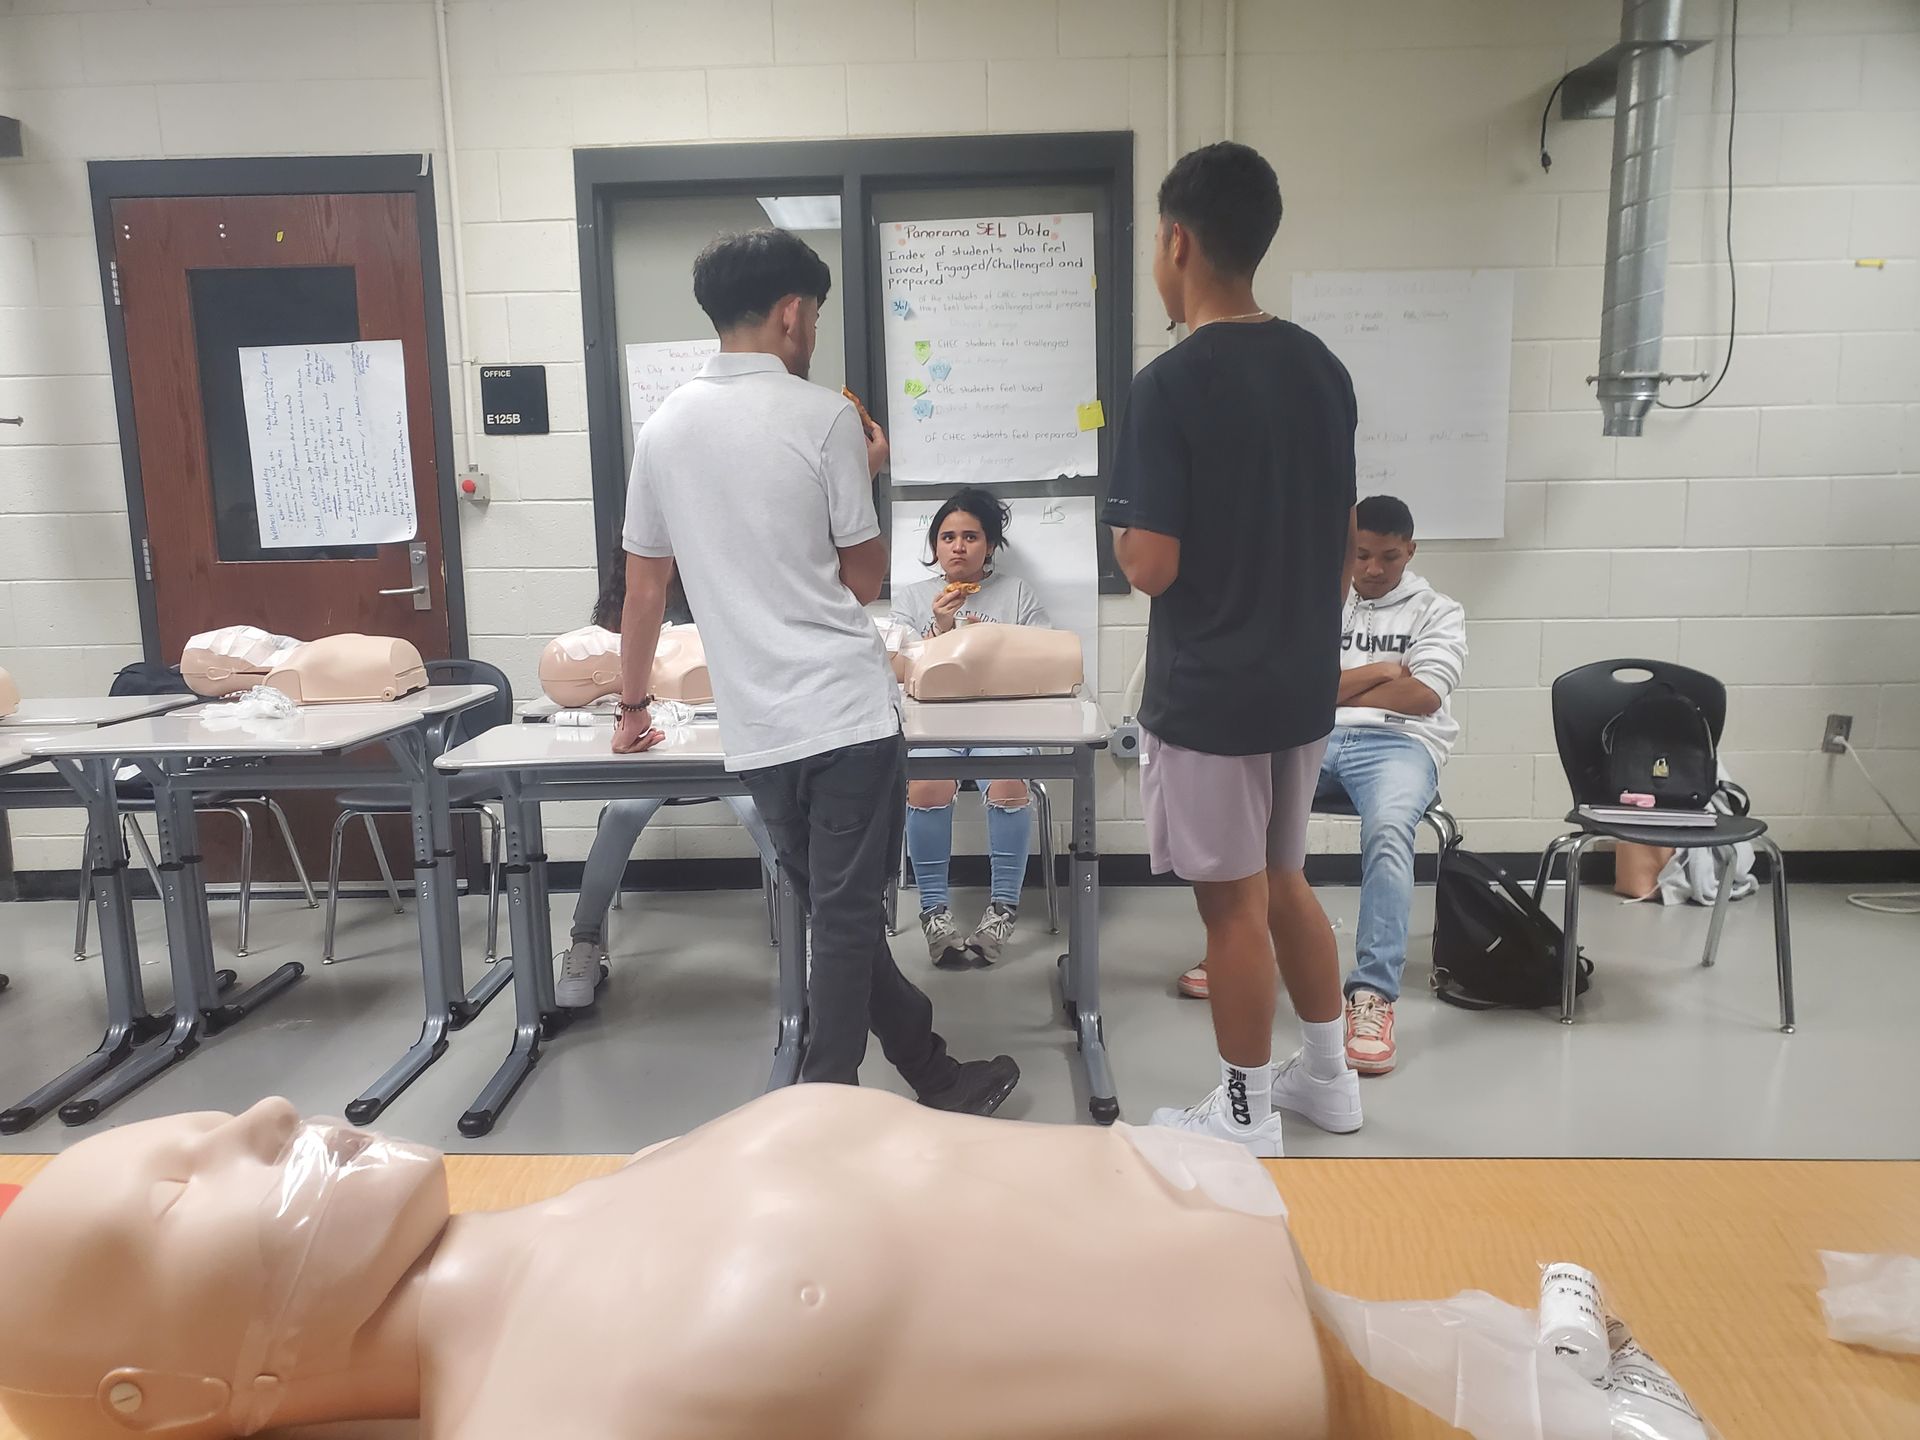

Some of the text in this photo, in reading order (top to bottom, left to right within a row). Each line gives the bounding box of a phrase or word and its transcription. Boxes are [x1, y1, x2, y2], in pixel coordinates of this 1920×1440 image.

[904, 222, 1050, 240] Panorama SEL Data
[888, 241, 1066, 261] Index of students who feel
[1059, 258, 1083, 269] and
[888, 276, 944, 290] prepared
[960, 384, 994, 393] students
[1000, 383, 1016, 393] feel
[486, 413, 521, 425] E125B
[972, 430, 1008, 439] students
[1012, 430, 1029, 439] feel
[1035, 431, 1078, 442] prepared
[1043, 505, 1066, 522] HS
